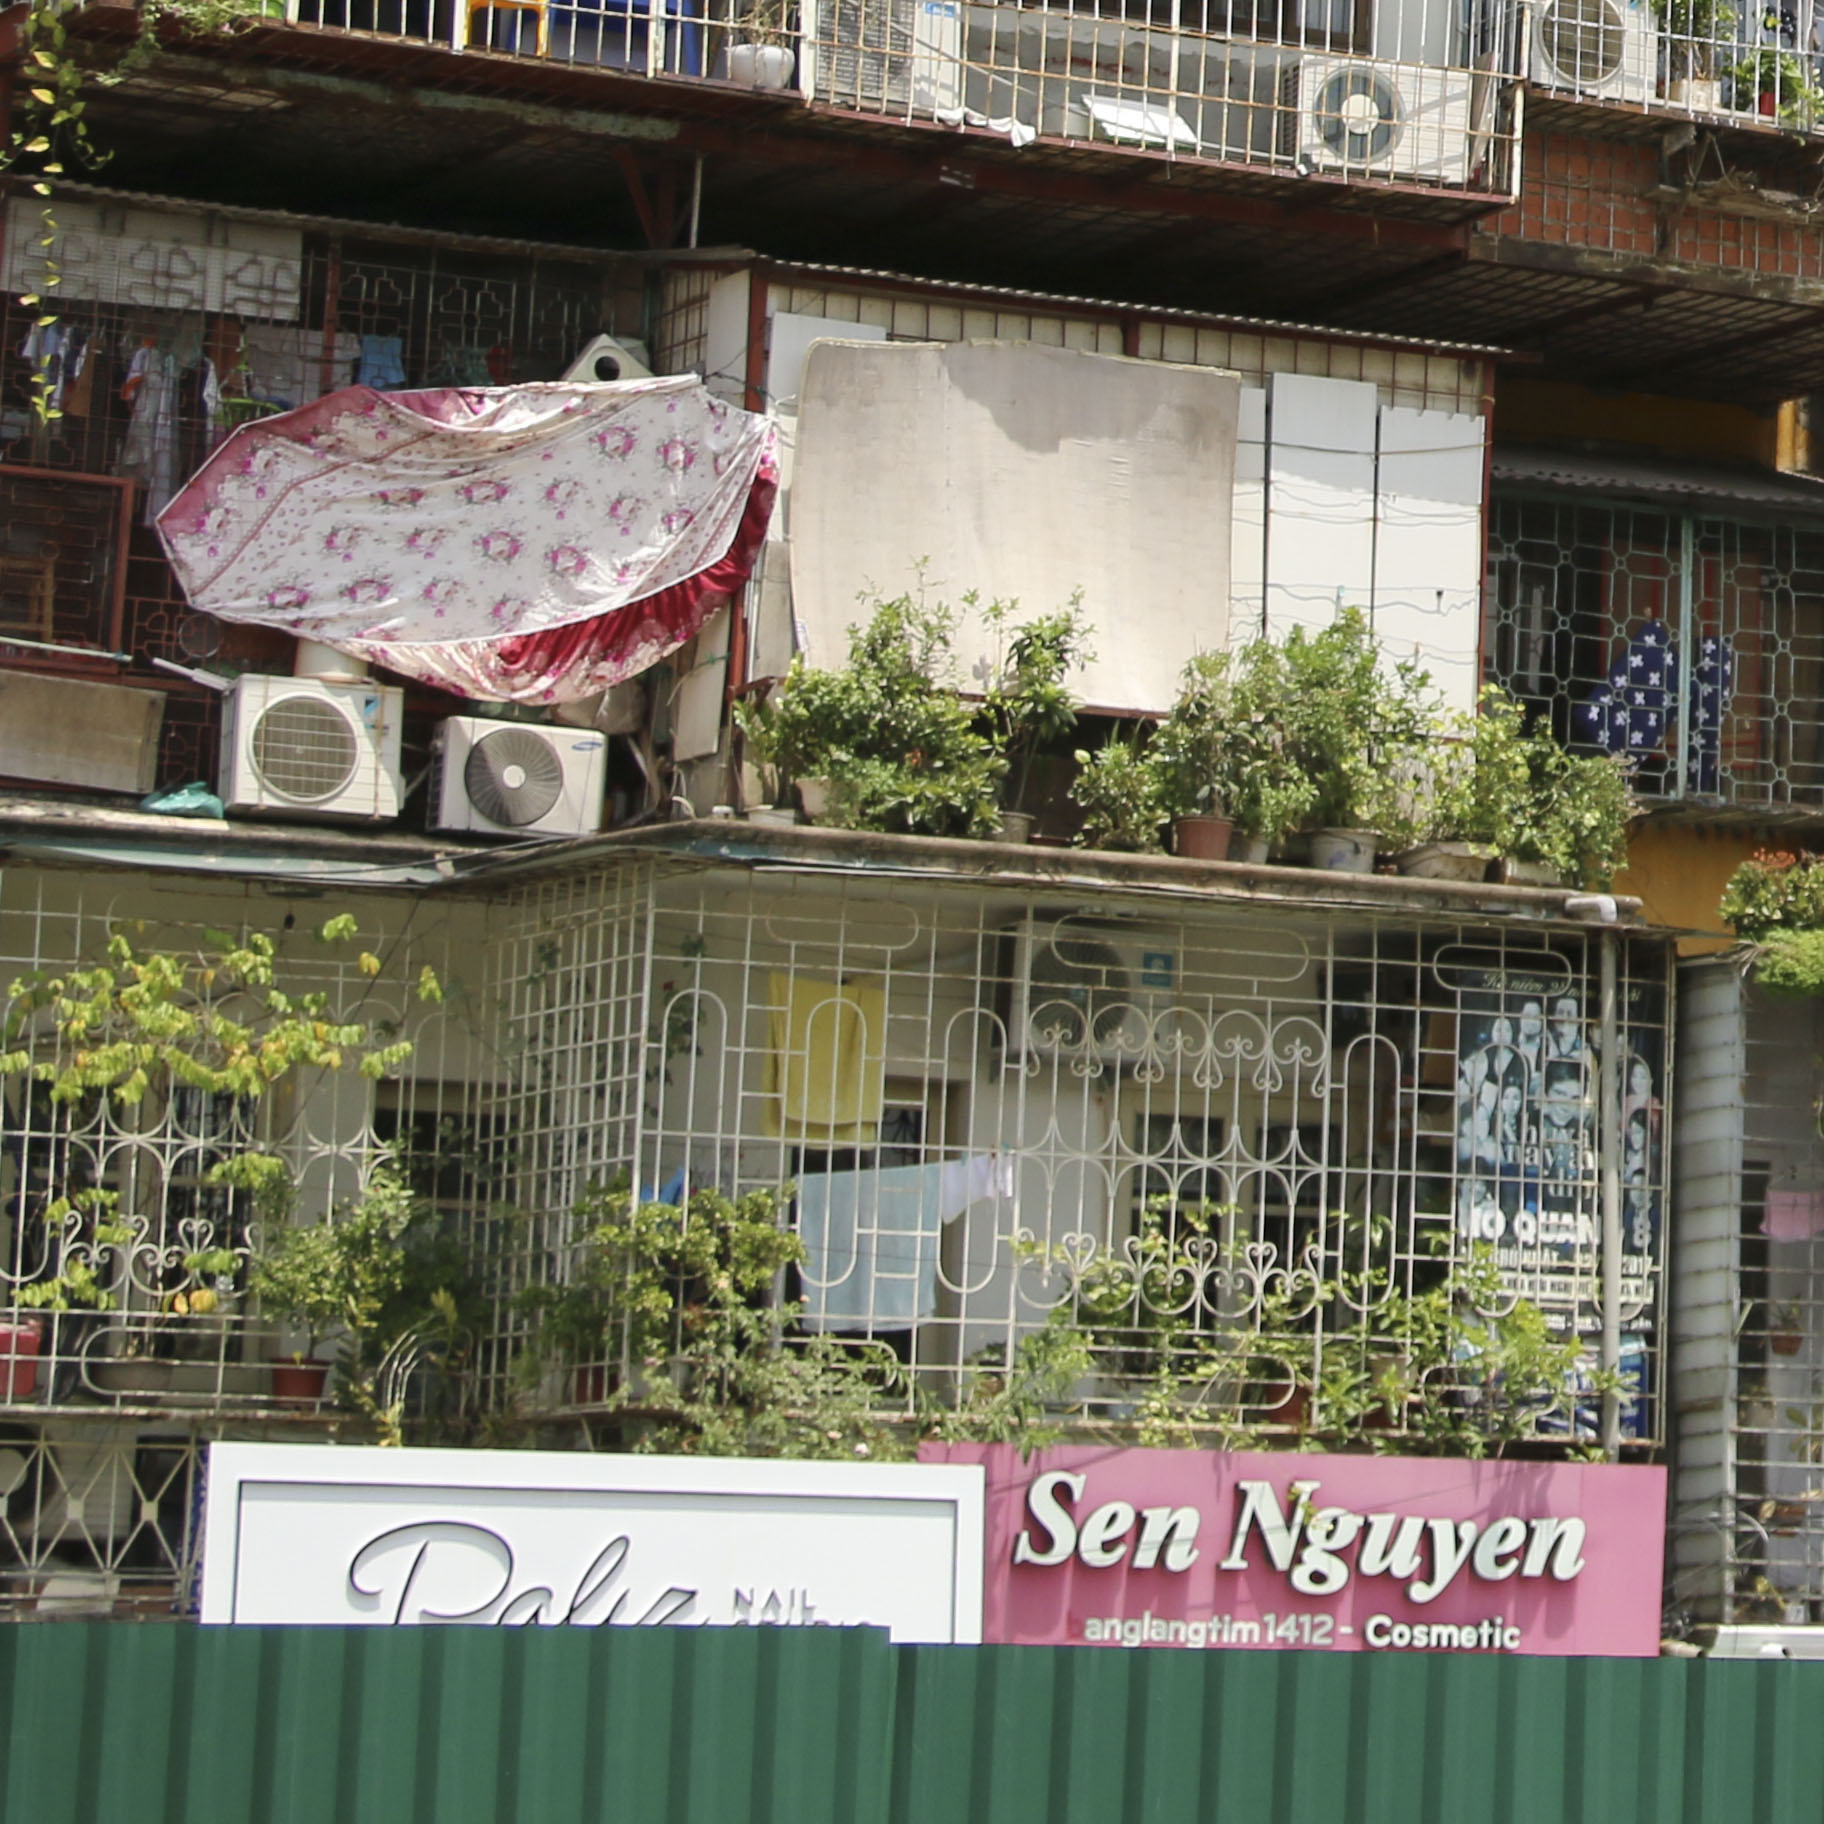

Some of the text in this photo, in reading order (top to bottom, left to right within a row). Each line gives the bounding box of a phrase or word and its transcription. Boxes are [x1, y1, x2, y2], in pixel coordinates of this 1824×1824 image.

[1013, 1470, 1587, 1604] Sen Nguyen
[734, 1587, 816, 1609] NAIL
[1365, 1614, 1521, 1649] Cosmetic
